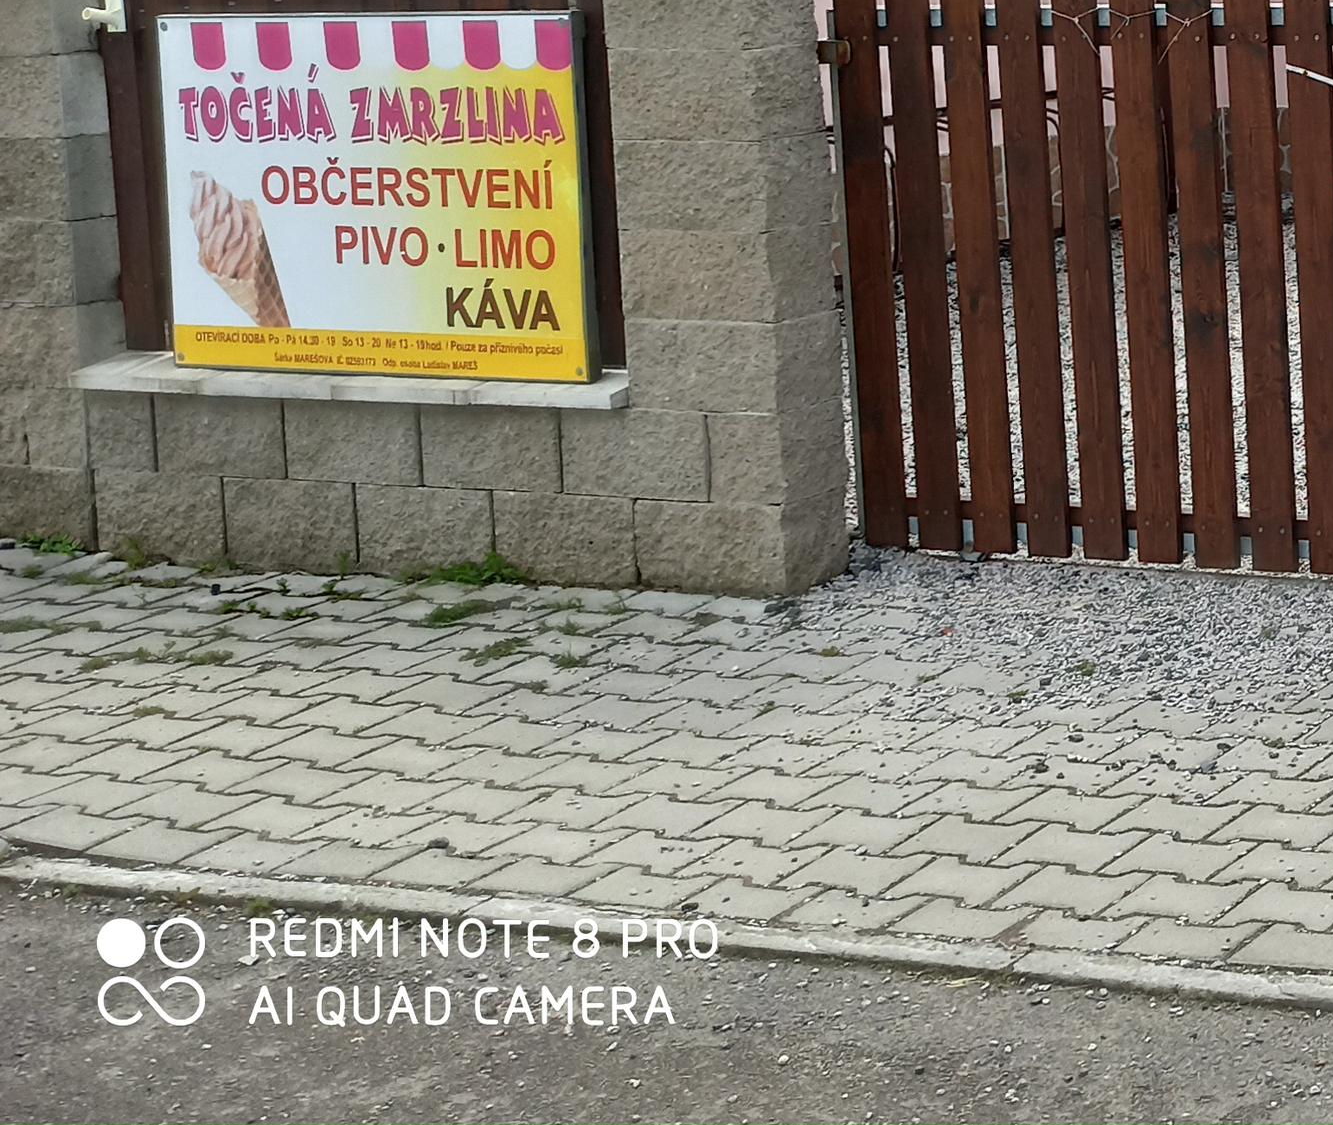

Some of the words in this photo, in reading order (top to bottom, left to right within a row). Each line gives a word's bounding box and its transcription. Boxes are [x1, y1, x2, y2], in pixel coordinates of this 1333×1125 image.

[179, 64, 337, 143] TOČENÁ
[350, 85, 565, 146] ZMRZLINA
[261, 157, 554, 210] OBČERSTVENÍ
[335, 225, 429, 267] PIVO
[454, 228, 556, 270] LIMO
[446, 279, 561, 331] KÁVA
[371, 337, 381, 348] 20
